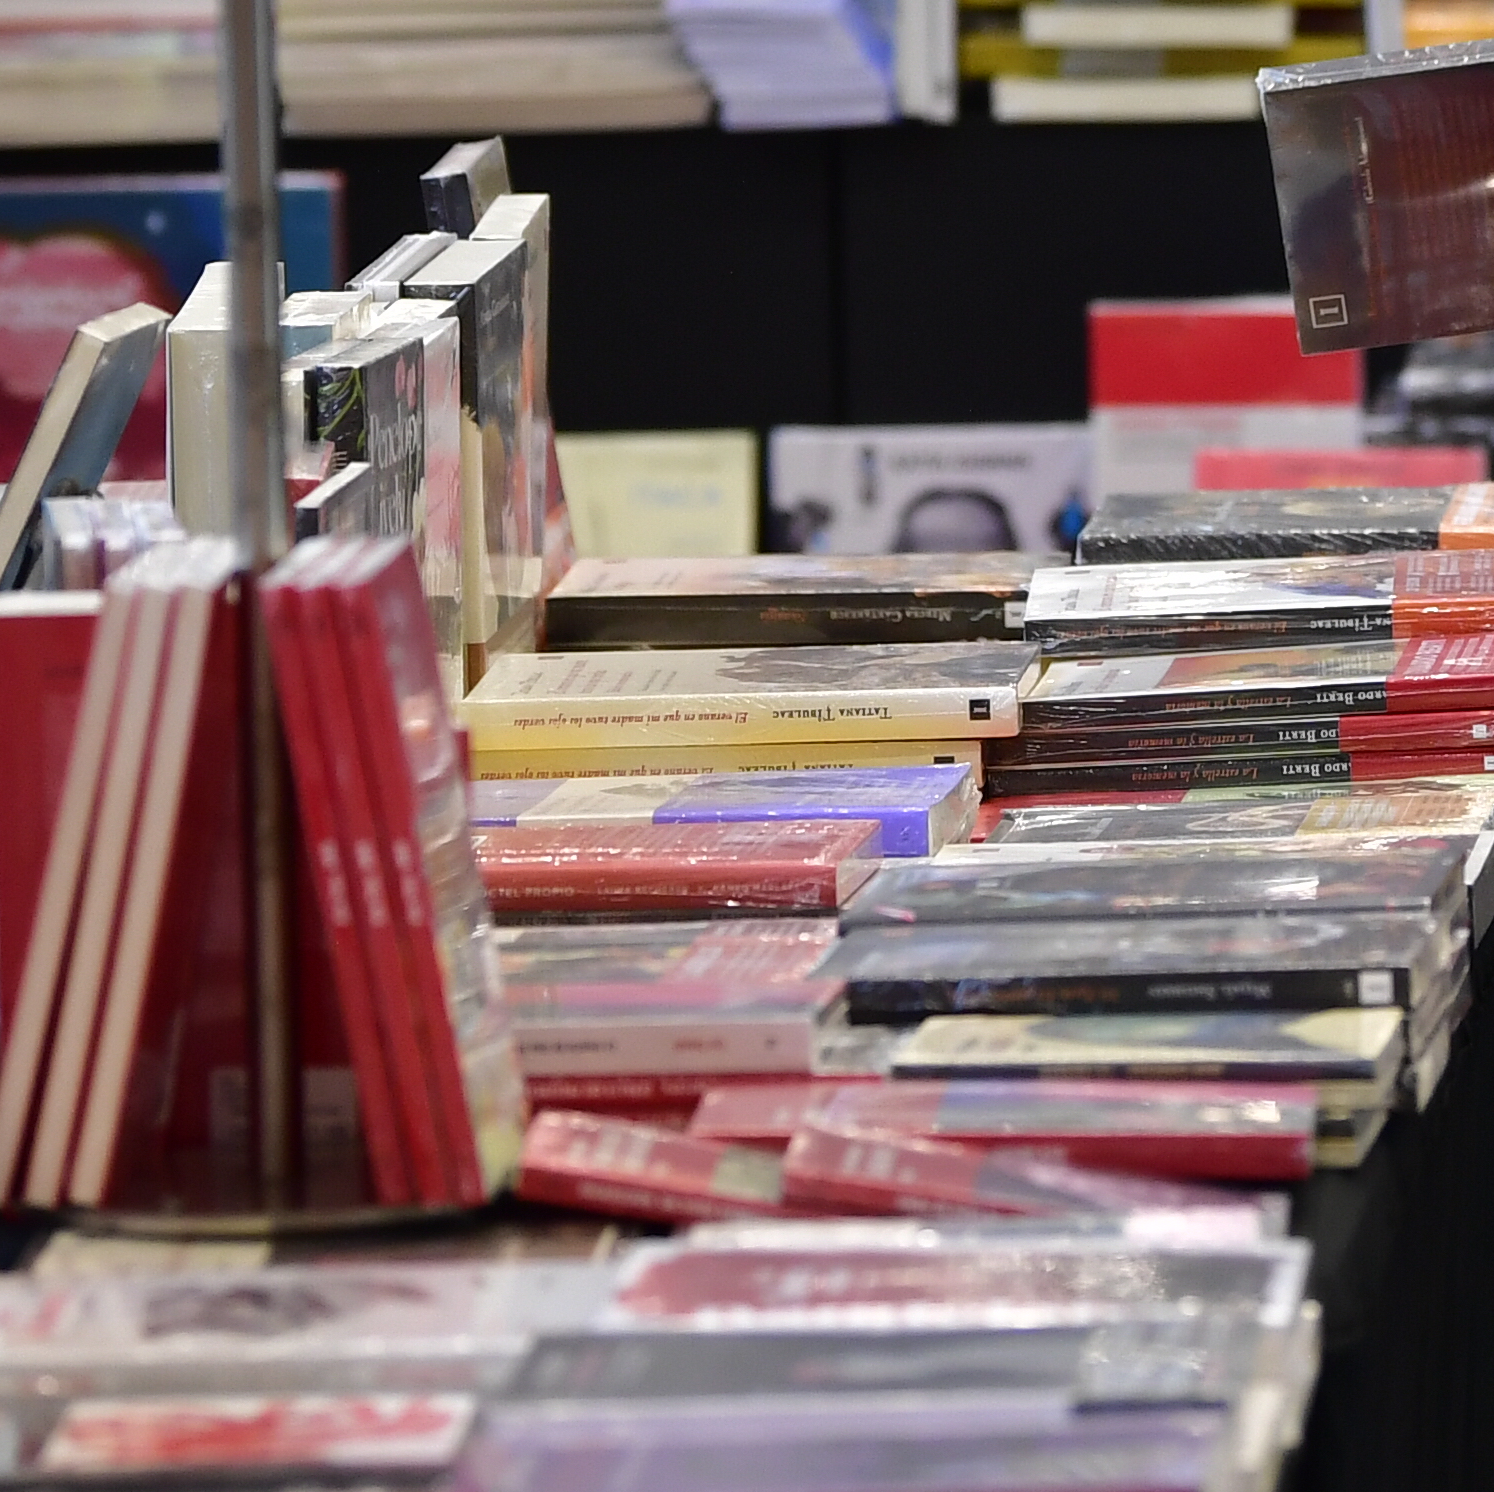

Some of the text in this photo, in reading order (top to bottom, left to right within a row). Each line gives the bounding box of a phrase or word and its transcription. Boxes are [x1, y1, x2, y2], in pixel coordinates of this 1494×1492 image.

[1315, 691, 1355, 706] BERTI
[646, 714, 661, 726] mi
[664, 710, 680, 723] que
[683, 714, 696, 722] en
[698, 713, 733, 723] verano
[735, 712, 748, 724] El
[839, 707, 893, 721] TATIANA
[514, 717, 545, 730] verdes
[548, 713, 567, 728] ojos
[570, 716, 583, 728] los
[585, 716, 608, 726] tuvo
[611, 715, 644, 727] madre
[1199, 735, 1236, 748] estrella
[1239, 734, 1254, 744] La
[1278, 730, 1317, 743] BERTI
[1128, 738, 1174, 748] memoria
[1180, 770, 1191, 782] la
[1202, 768, 1239, 782] estrella
[1243, 767, 1258, 779] La
[1282, 763, 1321, 777] BERTI
[1132, 772, 1177, 783] memoria
